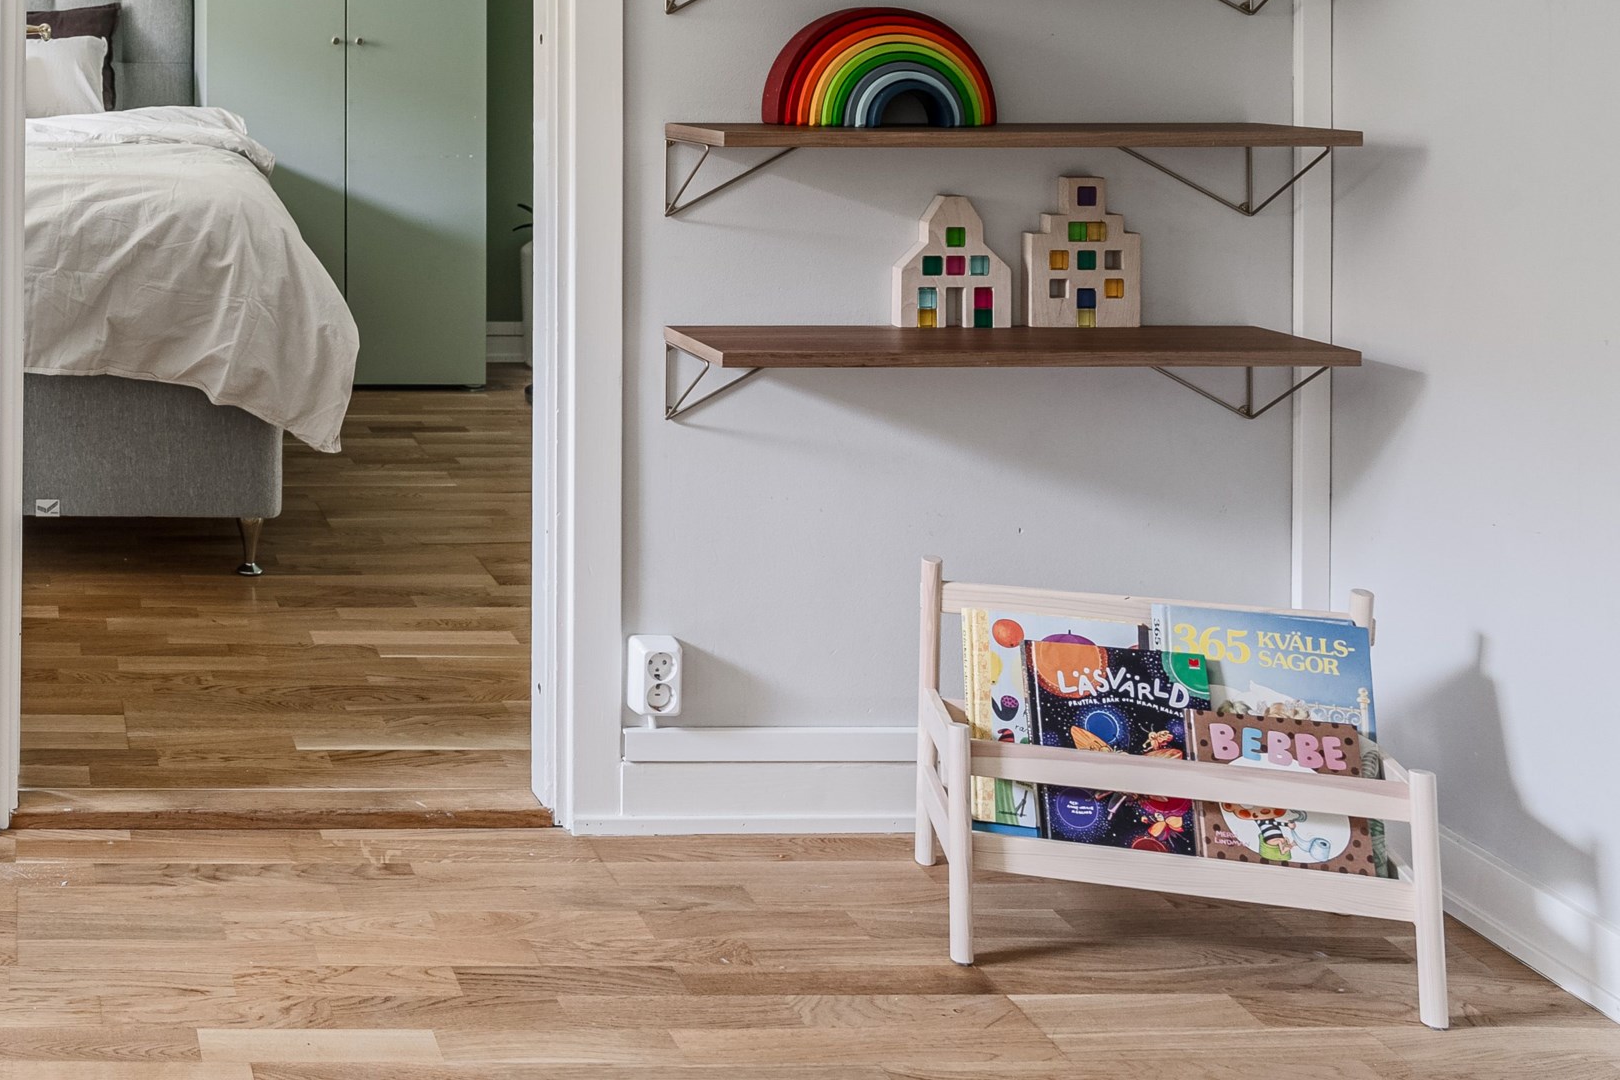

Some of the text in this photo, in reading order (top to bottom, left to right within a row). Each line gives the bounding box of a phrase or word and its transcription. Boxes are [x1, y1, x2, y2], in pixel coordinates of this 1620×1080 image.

[1153, 618, 1162, 646] 365
[1173, 623, 1356, 664] 365 KVÄLLS-
[1258, 651, 1340, 676] SAGOR
[1057, 667, 1190, 708] LÄSVÄRLD
[1209, 723, 1347, 770] BEBBE
